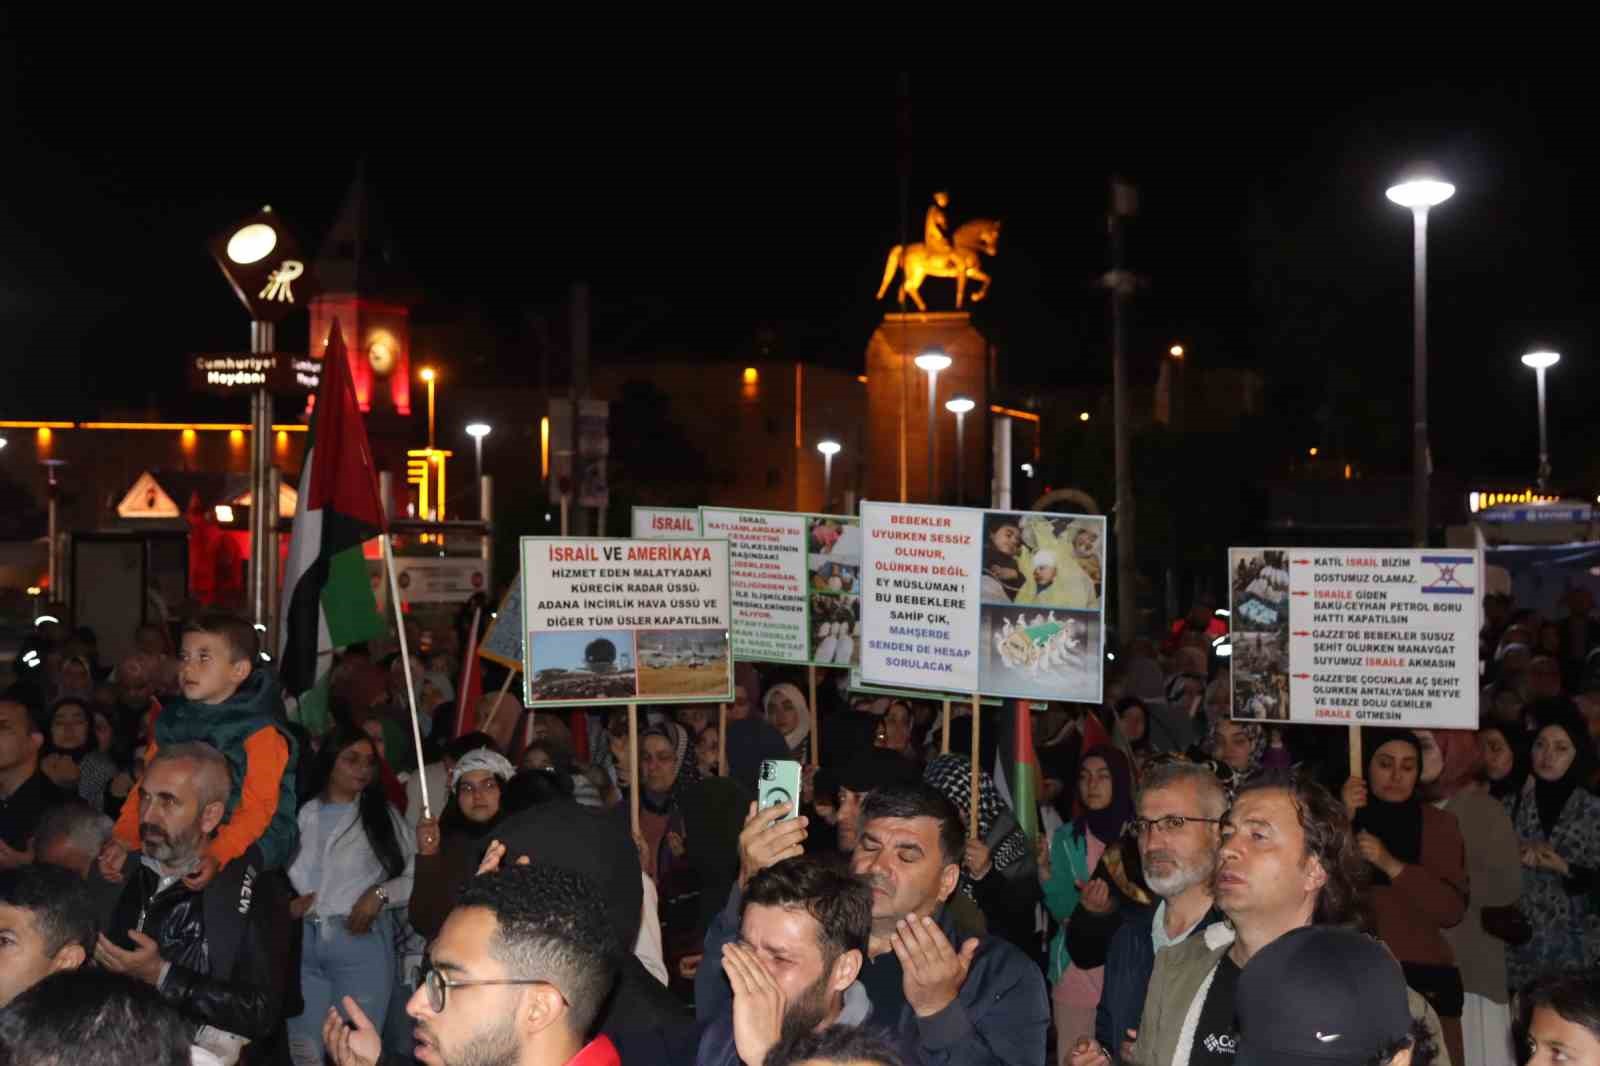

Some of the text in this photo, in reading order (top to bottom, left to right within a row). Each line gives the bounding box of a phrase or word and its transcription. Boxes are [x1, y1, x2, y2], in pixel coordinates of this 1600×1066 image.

[196, 357, 276, 371] Cumhuriyet
[207, 371, 266, 386] Meydanı
[652, 514, 694, 531] İSRAİL
[890, 515, 951, 527] BEBEKLER
[872, 529, 927, 541] UYURKEN
[549, 544, 712, 561] İSRAİL VE AMERİKAYA
[895, 547, 945, 560] OLUNUR,
[875, 560, 928, 574] ÖLÜRKEN
[1314, 556, 1411, 567] KATİL İSRAİL BİZİM
[552, 567, 712, 578] HİZMET EDEN MALATYADAKİ
[1314, 573, 1370, 583] DOSTUMUZ
[571, 582, 623, 593] KÜRECİK
[627, 583, 664, 593] RADAR
[876, 578, 890, 587] EY
[893, 579, 958, 592] MÜSLÜMAN
[1314, 589, 1387, 600] İSRAİLE GİDEN
[538, 597, 718, 610] ADANA İNCİRLİK HAVA ÜSSÜ VE
[875, 593, 966, 609] BU BEBEKLERE
[1390, 602, 1430, 612] PETROL
[1433, 602, 1462, 612] BORU
[547, 615, 722, 627] DİĞER TÜM ÜSLER KAPATILSIN.
[889, 610, 924, 620] SAHİP
[1313, 614, 1408, 624] HATTI KAPATILSIN
[889, 625, 951, 640] MAHŞERDE
[1364, 631, 1417, 640] BEBEKLER
[1420, 632, 1455, 641] SUSUZ
[869, 640, 971, 658] SENDEN DE HESAP
[1313, 642, 1342, 652] ŞEHİT
[1397, 644, 1455, 654] MANAVGAT
[885, 657, 952, 672] SORULACAK
[1313, 656, 1455, 668] SUYUMUZ İSRAİLE AKMASIN
[1361, 675, 1412, 685] ÇOCUKLAR
[1415, 676, 1428, 686] AÇ
[1431, 677, 1460, 686] ŞEHİT
[1427, 688, 1461, 698] MEYVE
[1314, 697, 1432, 709] VE SEBZE DOLU GEMİLER
[1315, 708, 1402, 720] İSRAİLE GİTMESİN
